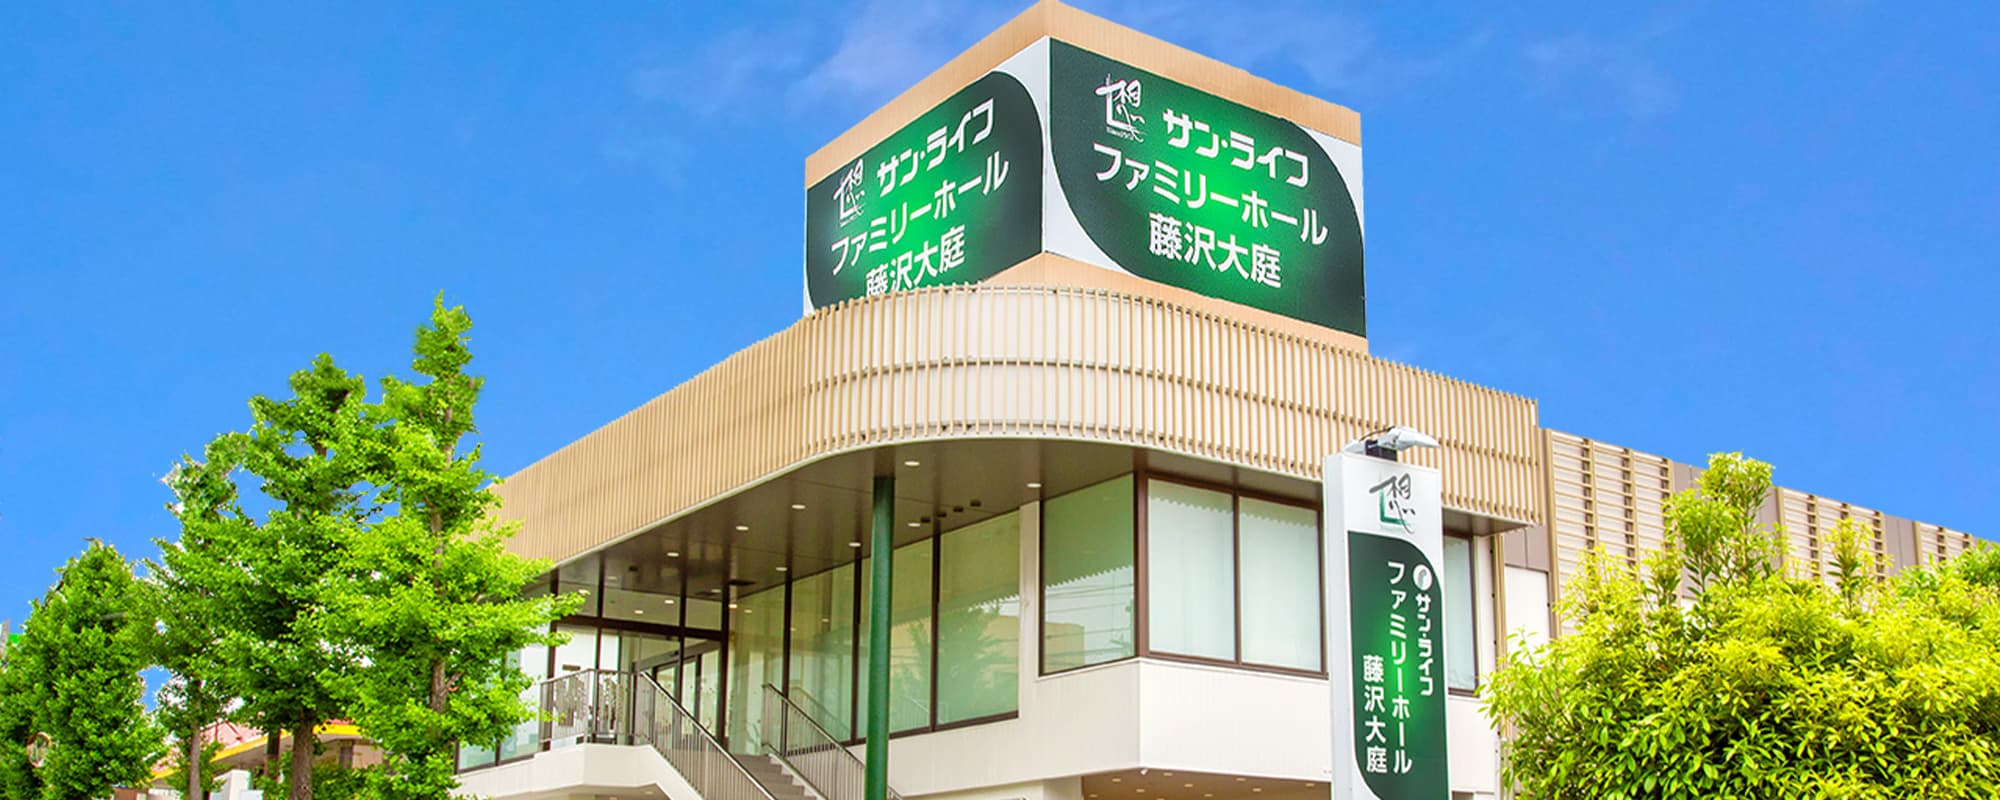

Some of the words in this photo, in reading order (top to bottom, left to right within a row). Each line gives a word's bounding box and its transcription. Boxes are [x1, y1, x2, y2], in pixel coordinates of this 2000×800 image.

[877, 97, 994, 197] サン・ライフ
[1093, 142, 1328, 245] ファミリーホール
[1163, 108, 1309, 187] サン・ライフ
[831, 151, 1009, 276] ファミリーホール
[865, 224, 965, 298] 藤沢大庭
[1149, 212, 1281, 288] 藤沢大庭
[1363, 655, 1388, 774] 藤沢大庭
[1387, 562, 1412, 775] ファミリーホール
